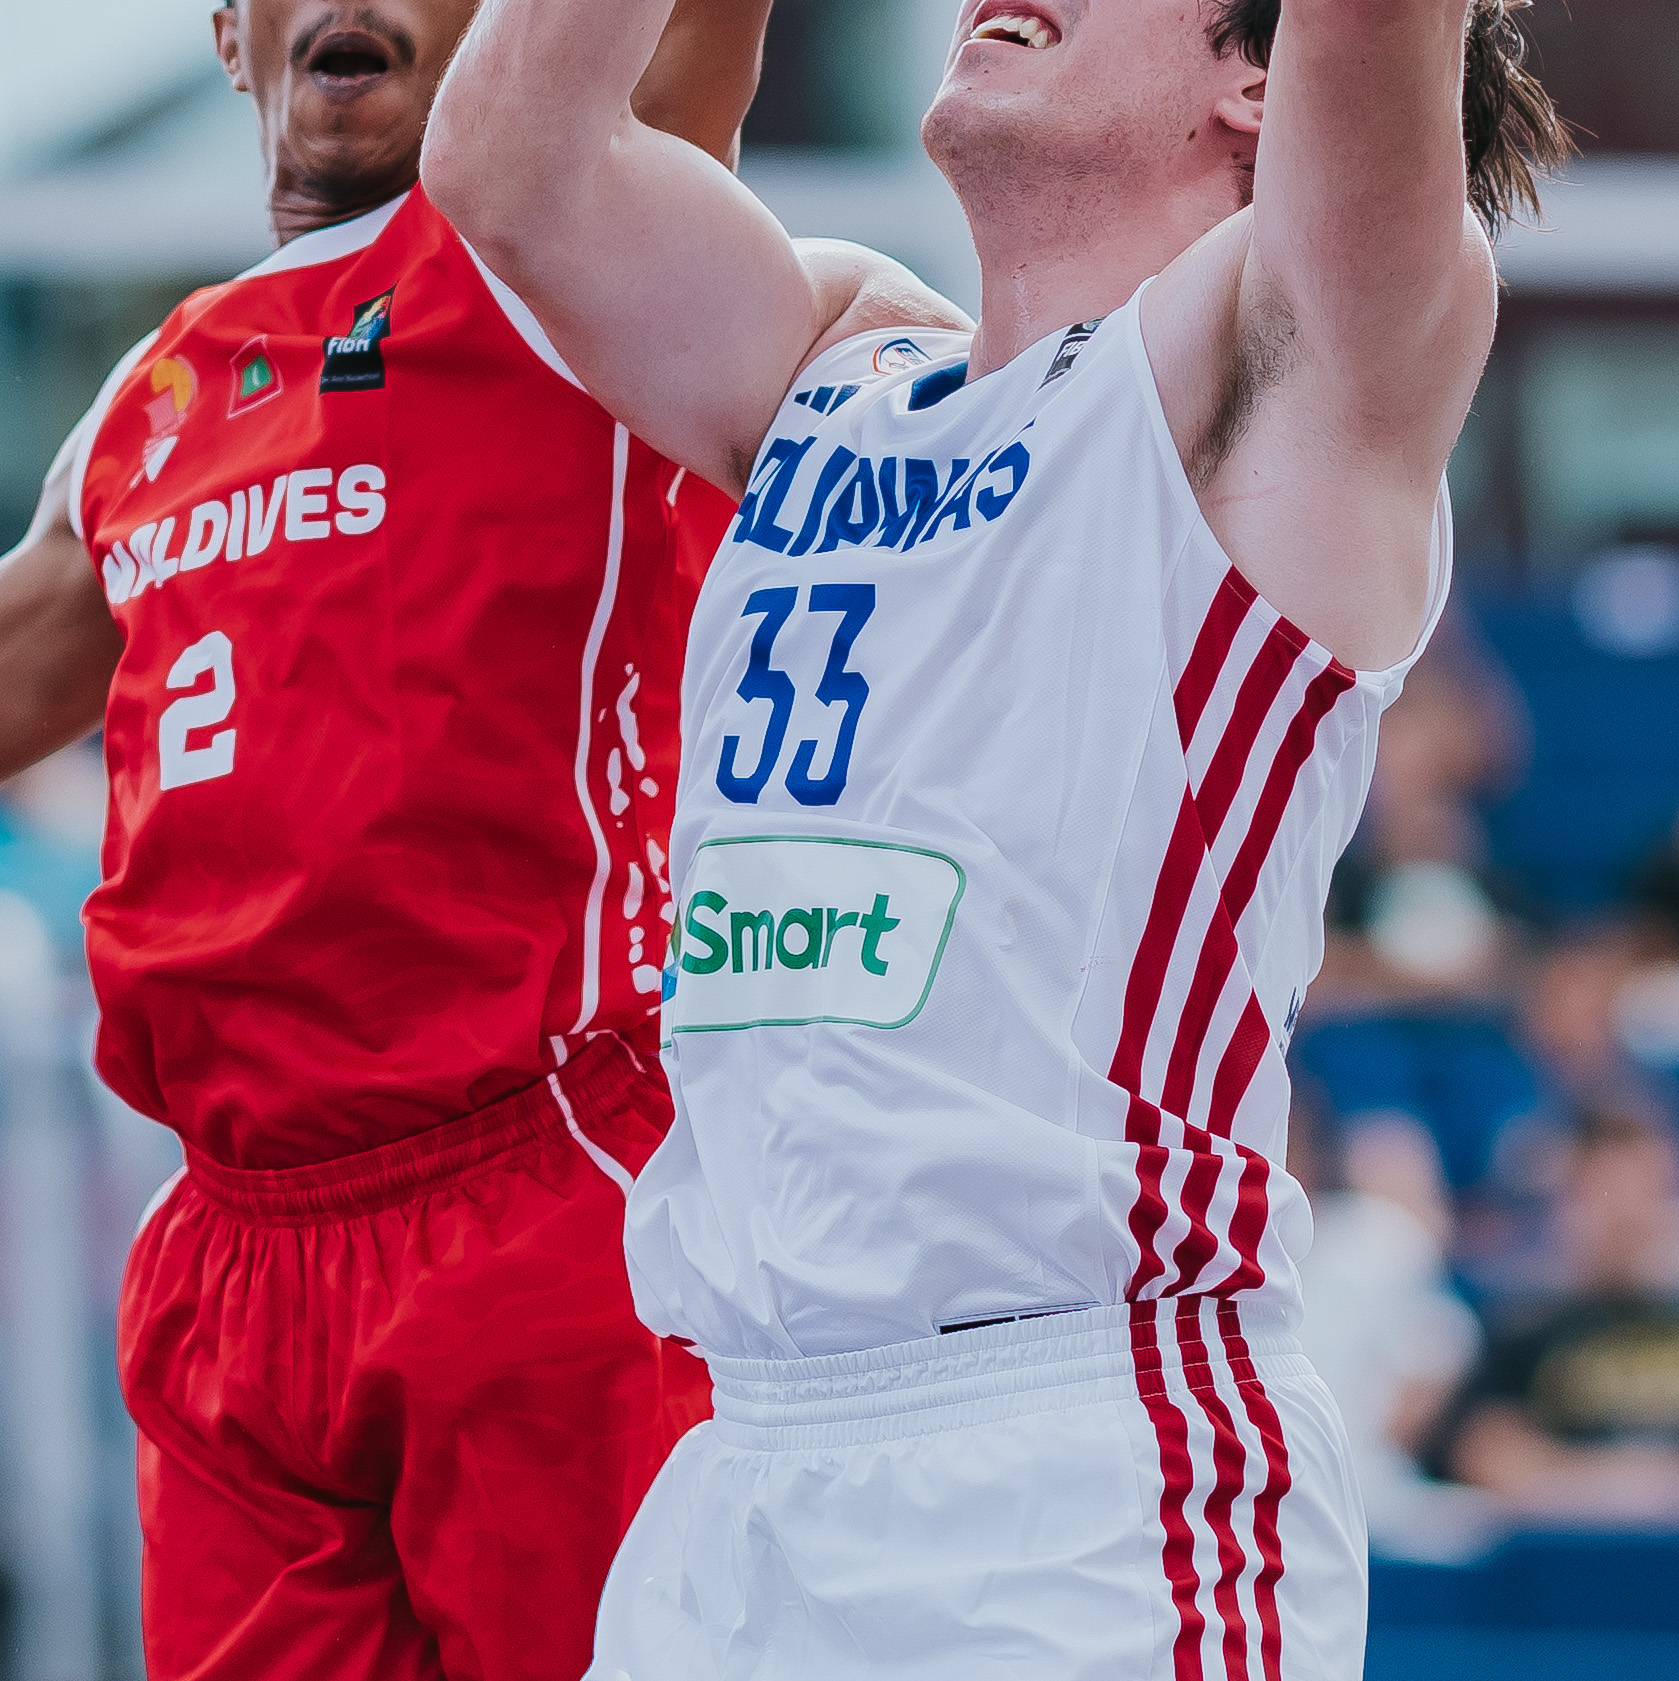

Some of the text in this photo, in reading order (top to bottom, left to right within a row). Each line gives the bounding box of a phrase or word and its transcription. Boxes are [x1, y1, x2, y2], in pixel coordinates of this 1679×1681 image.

[158, 629, 237, 791] 2
[714, 582, 877, 807] 33
[680, 890, 902, 977] Smart
